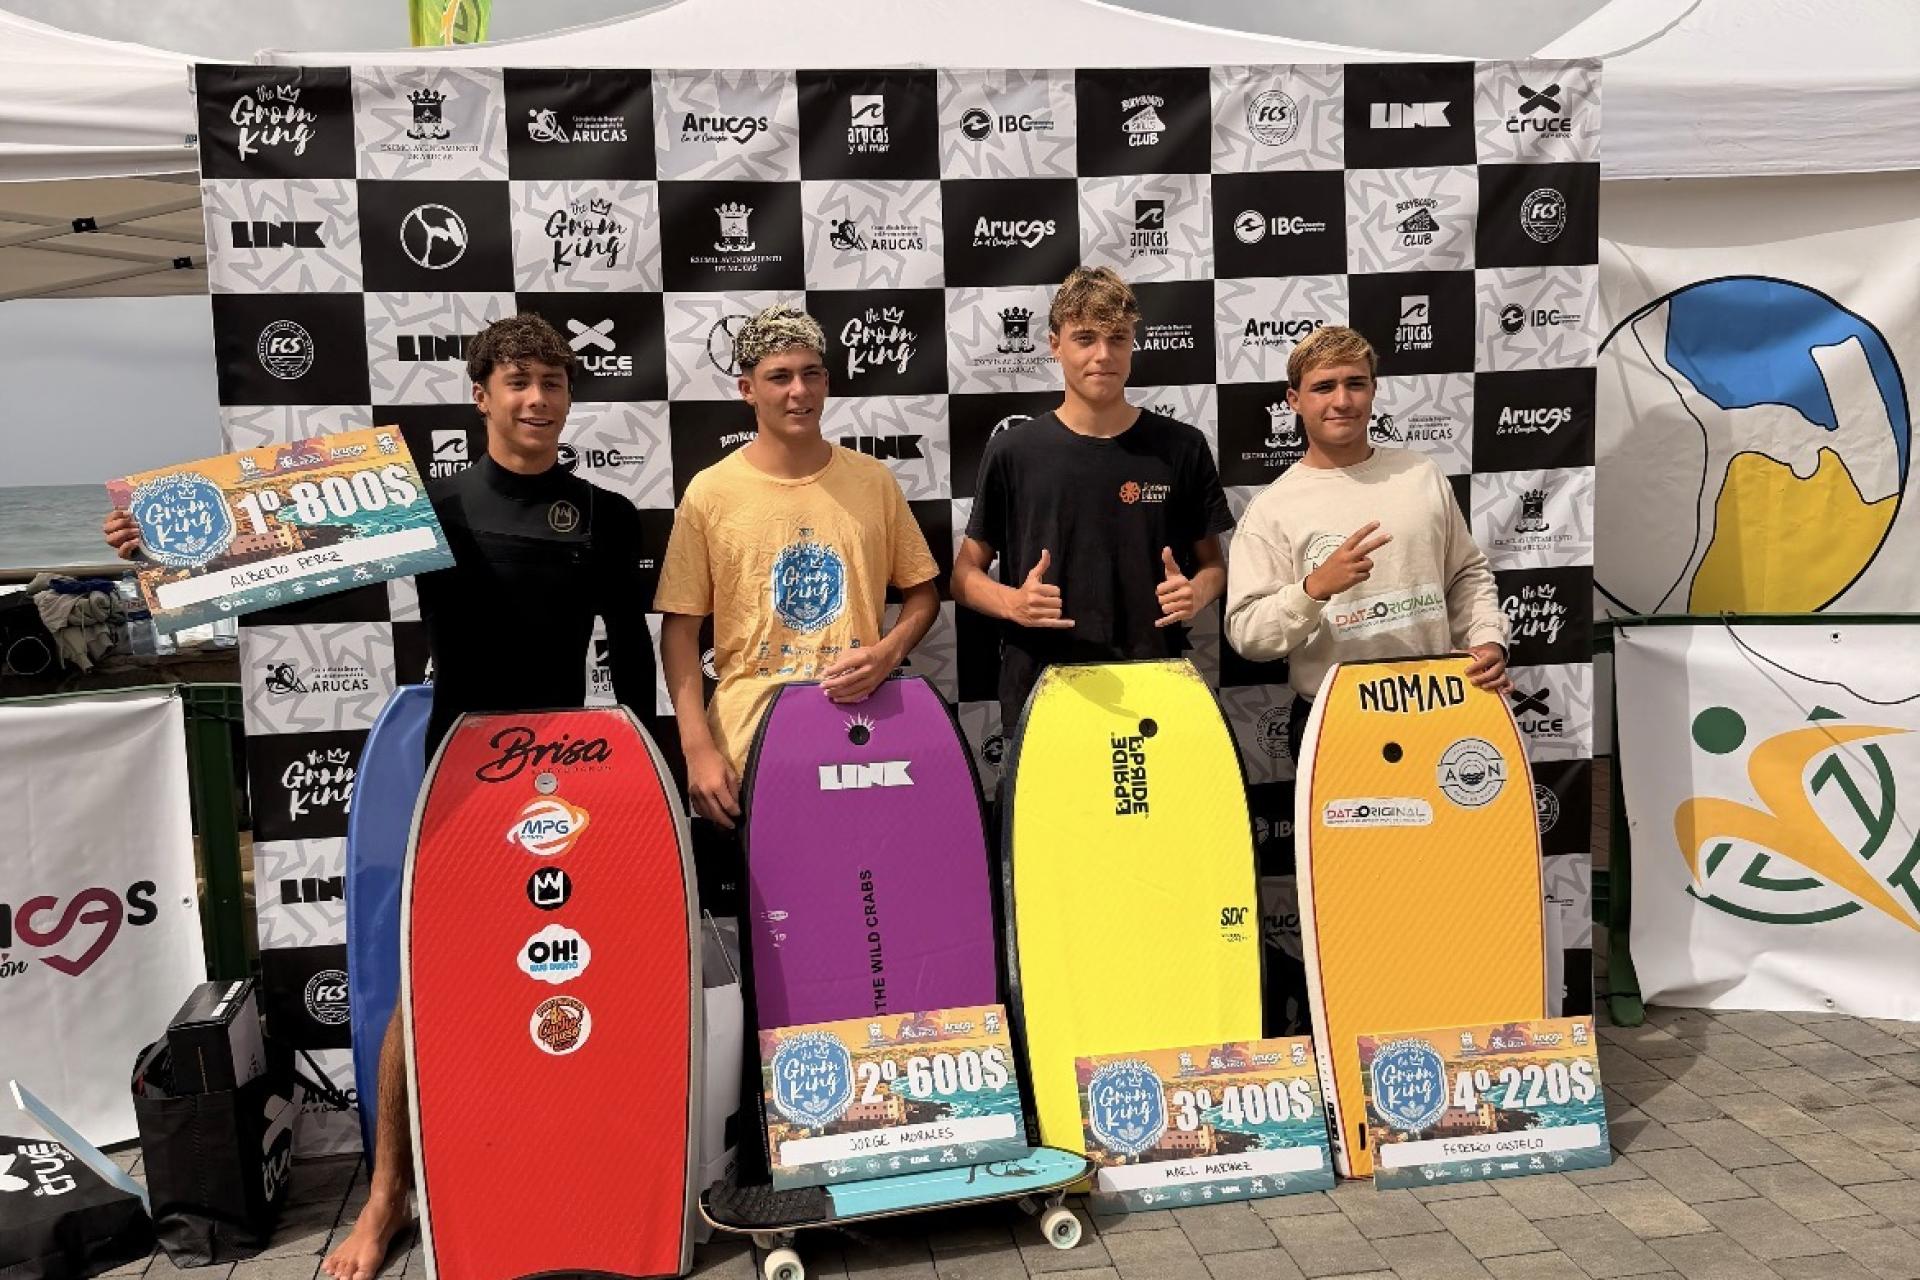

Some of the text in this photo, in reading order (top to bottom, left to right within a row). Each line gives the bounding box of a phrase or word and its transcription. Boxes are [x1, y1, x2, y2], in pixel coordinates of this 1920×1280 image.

[230, 95, 317, 126] Grom
[1258, 106, 1287, 121] FCS
[1370, 101, 1452, 129] LINK
[572, 129, 628, 142] ARUCAS
[682, 113, 768, 144] Arucas
[847, 127, 889, 143] arucas
[998, 115, 1033, 133] IBC
[237, 119, 316, 161] King
[1128, 133, 1160, 147] CLUB
[1531, 203, 1558, 219] FCS
[231, 221, 326, 248] LINK
[544, 209, 627, 238] Grom
[973, 216, 1056, 248] Arucas
[1271, 217, 1304, 235] IBC
[871, 238, 923, 250] ARUCAS
[1130, 231, 1168, 247] arucas
[1403, 233, 1433, 247] CLUB
[552, 231, 627, 273] King
[1530, 309, 1560, 328] IBC
[840, 318, 918, 346] Grom
[1395, 324, 1432, 341] arucas
[270, 337, 301, 353] FCS
[1143, 338, 1194, 351] ARUCAS
[576, 356, 632, 371] UCE
[847, 341, 917, 379] King
[1498, 406, 1572, 435] Arucas
[1405, 428, 1453, 441] ARUCAS
[429, 461, 473, 480] aruca
[586, 449, 621, 468] IBC
[145, 500, 214, 525] Grom
[241, 489, 280, 536] 1º
[155, 511, 216, 549] King
[230, 565, 289, 588] ALBERTO
[1501, 595, 1568, 621] Grom
[311, 679, 369, 693] ARUCAS
[1359, 674, 1465, 713] NOMAD
[1518, 719, 1563, 733] UCE
[475, 726, 613, 783] Brisa
[281, 761, 357, 789] Grom
[819, 760, 914, 790] LINK
[289, 782, 354, 821] King
[521, 820, 569, 834] MPG
[1274, 821, 1296, 838] IB
[280, 876, 346, 904] LIN
[528, 938, 578, 964] OH!
[859, 869, 888, 1011] THE WILD CRABS
[318, 985, 348, 1001] FCS
[784, 1058, 840, 1081] Grom
[858, 1059, 897, 1104] 2º
[1381, 1064, 1435, 1086] Grom
[790, 1072, 841, 1105] King
[1099, 1085, 1154, 1107] Grom
[1388, 1079, 1437, 1109] King
[1453, 1069, 1491, 1113] 4º
[1106, 1100, 1155, 1132] King
[1173, 1088, 1212, 1132] 3º
[849, 1127, 954, 1151] JORGE MORALES
[1443, 1138, 1544, 1155] FEDERICO CASTELO
